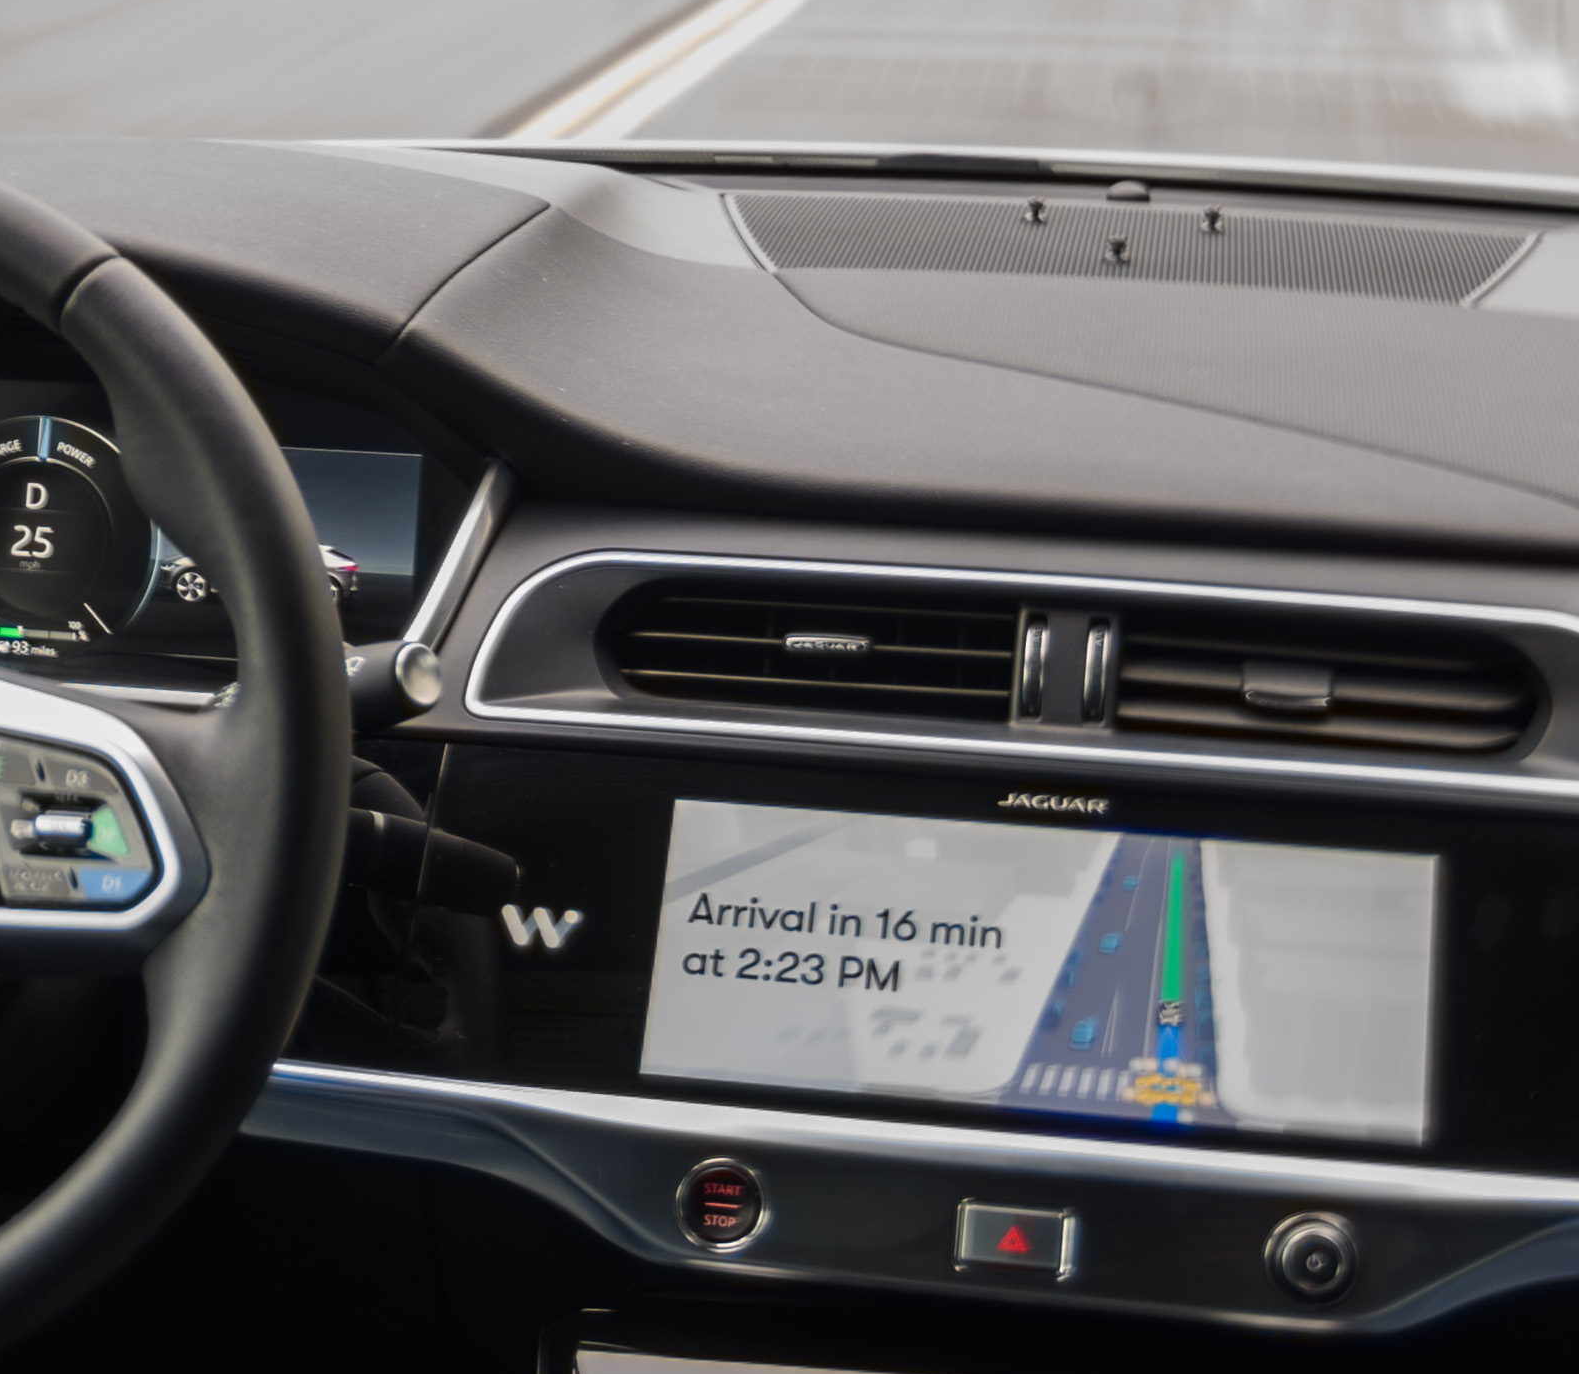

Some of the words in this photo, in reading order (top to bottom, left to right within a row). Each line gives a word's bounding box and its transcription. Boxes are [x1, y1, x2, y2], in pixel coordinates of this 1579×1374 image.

[56, 441, 96, 468] POWER
[25, 482, 49, 510] D
[10, 524, 54, 558] 25
[19, 560, 41, 571] mph
[11, 640, 30, 655] 93
[30, 645, 57, 657] miles
[997, 792, 1109, 814] JAGUAR
[687, 893, 818, 934] Arrival
[828, 903, 863, 938] in
[875, 908, 918, 942] 16
[929, 915, 1003, 949] min
[682, 948, 725, 977] at
[735, 947, 826, 985] 2:23
[837, 955, 901, 993] PM
[704, 1182, 742, 1196] START
[704, 1214, 738, 1227] STOP
